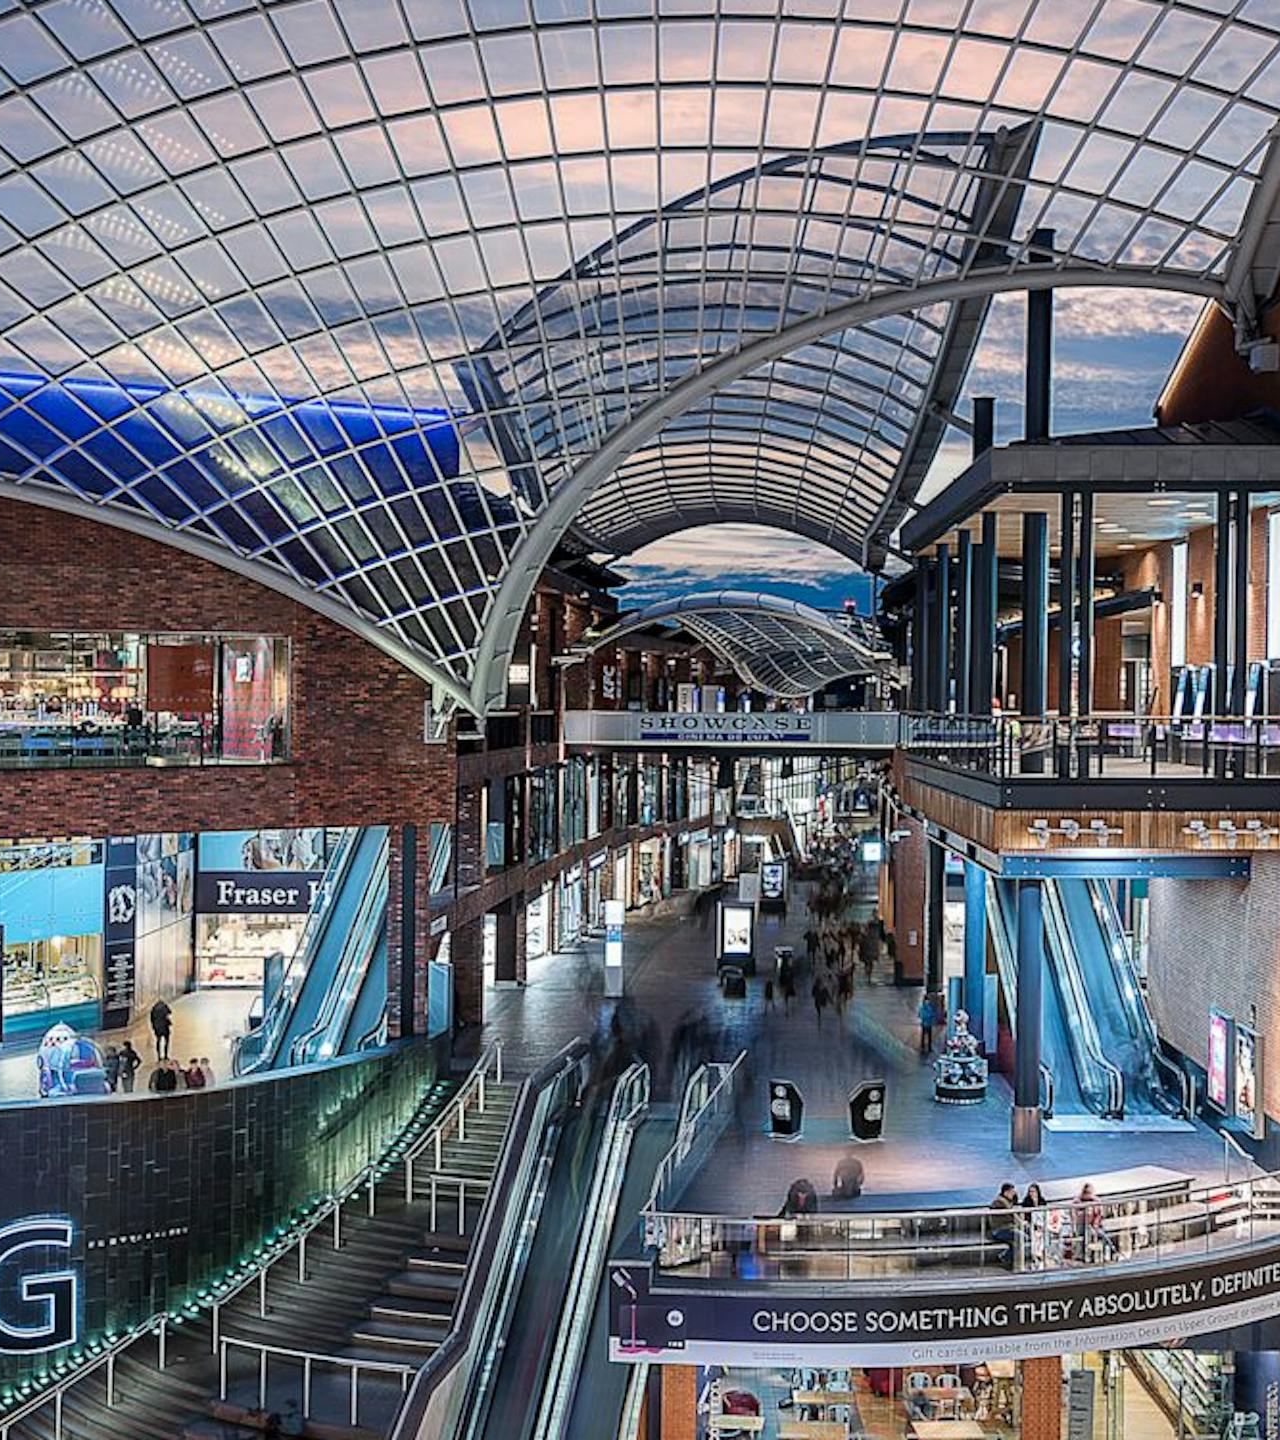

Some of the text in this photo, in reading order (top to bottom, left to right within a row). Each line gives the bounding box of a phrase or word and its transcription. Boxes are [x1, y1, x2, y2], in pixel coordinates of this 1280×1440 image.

[603, 665, 616, 699] KFC
[640, 717, 812, 731] SHOWCASE
[216, 880, 300, 906] Fraser
[752, 1310, 858, 1332] CHOOSE
[866, 1305, 1008, 1332] SOMETHING
[1015, 1300, 1073, 1324] THEY
[1078, 1281, 1206, 1319] ABSOLUTELY,
[913, 1347, 933, 1360] Gift
[937, 1345, 968, 1359] cards
[972, 1342, 1021, 1357] available
[1025, 1340, 1050, 1352] from
[1054, 1337, 1071, 1349] the
[1075, 1331, 1136, 1348] Information
[1138, 1325, 1160, 1337] Desk
[1164, 1323, 1176, 1333] on
[1179, 1317, 1206, 1333] Upper
[1207, 1310, 1239, 1327] Ground
